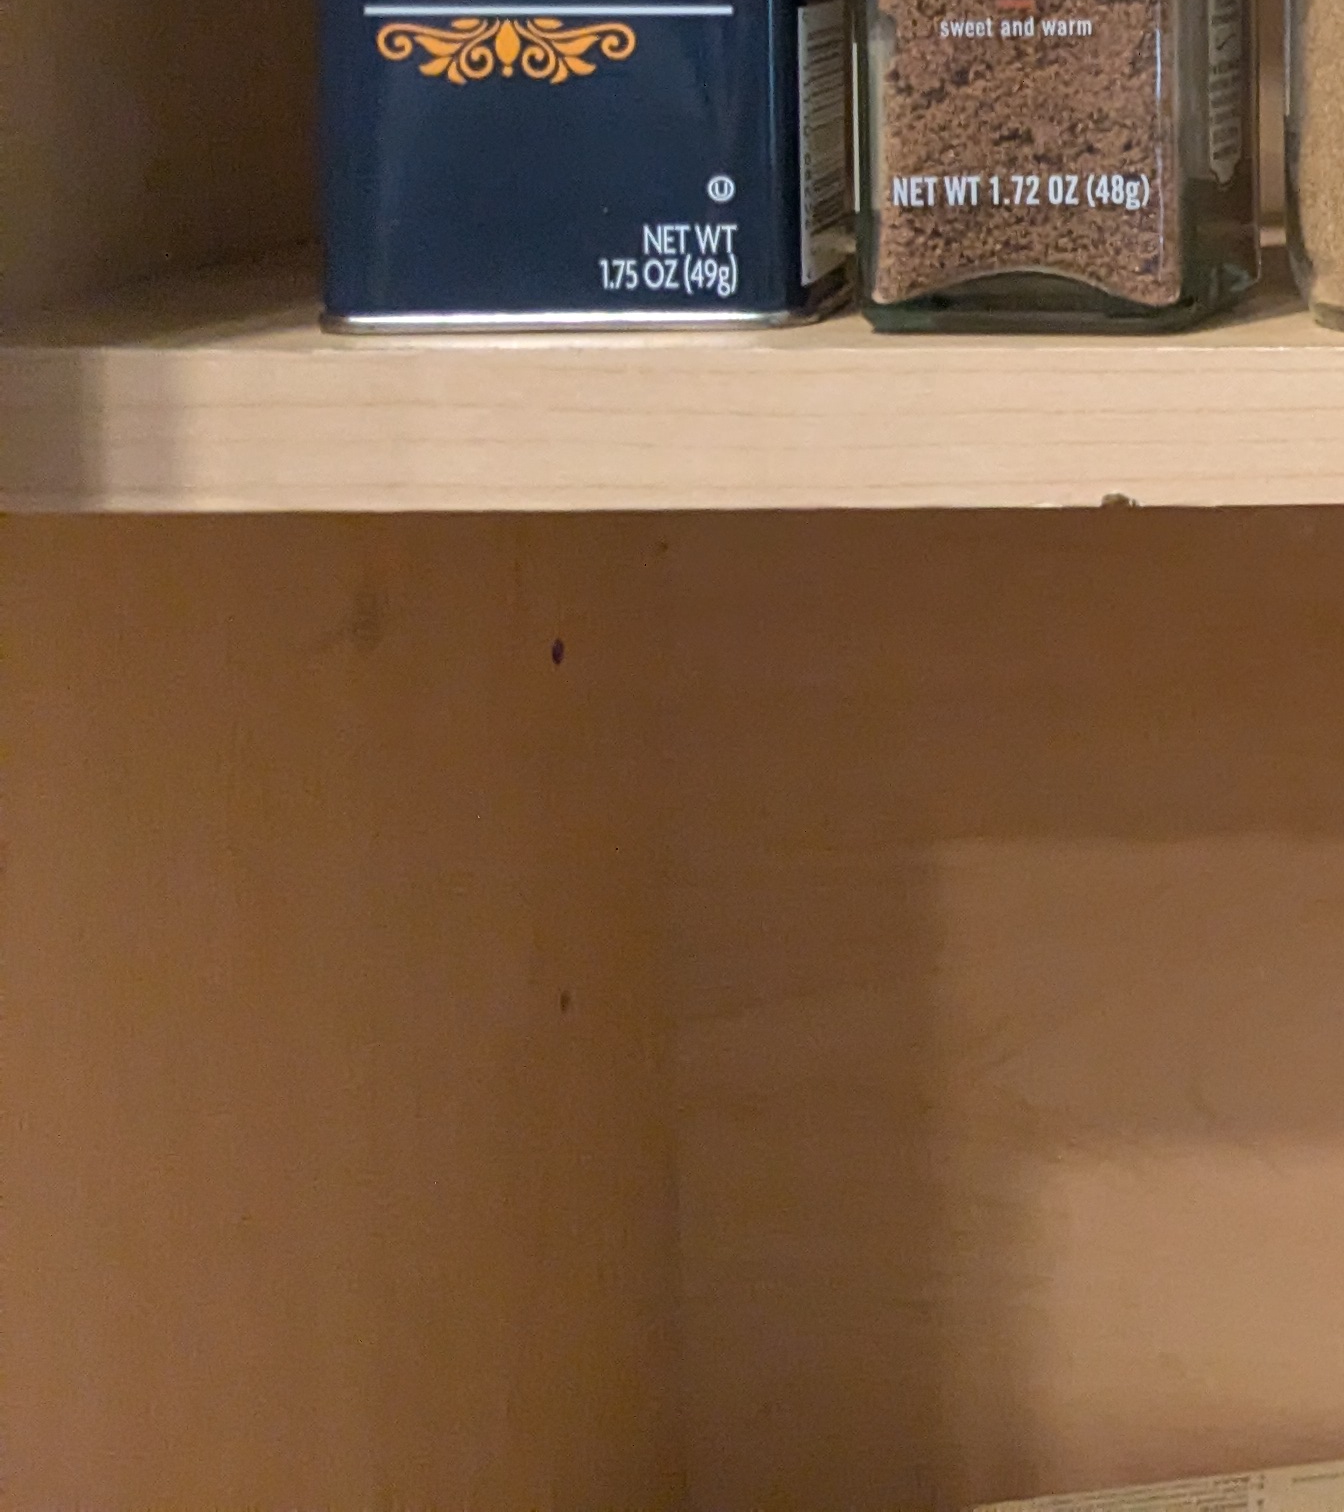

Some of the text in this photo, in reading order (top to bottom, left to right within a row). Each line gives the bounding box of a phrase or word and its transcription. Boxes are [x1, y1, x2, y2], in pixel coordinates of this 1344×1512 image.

[940, 16, 1092, 38] sweet and warm
[893, 174, 1150, 210] NET WT 1.72 OZ (48g)
[643, 225, 737, 254] NET WT
[600, 256, 737, 297] 1.75 OZ (49g)
